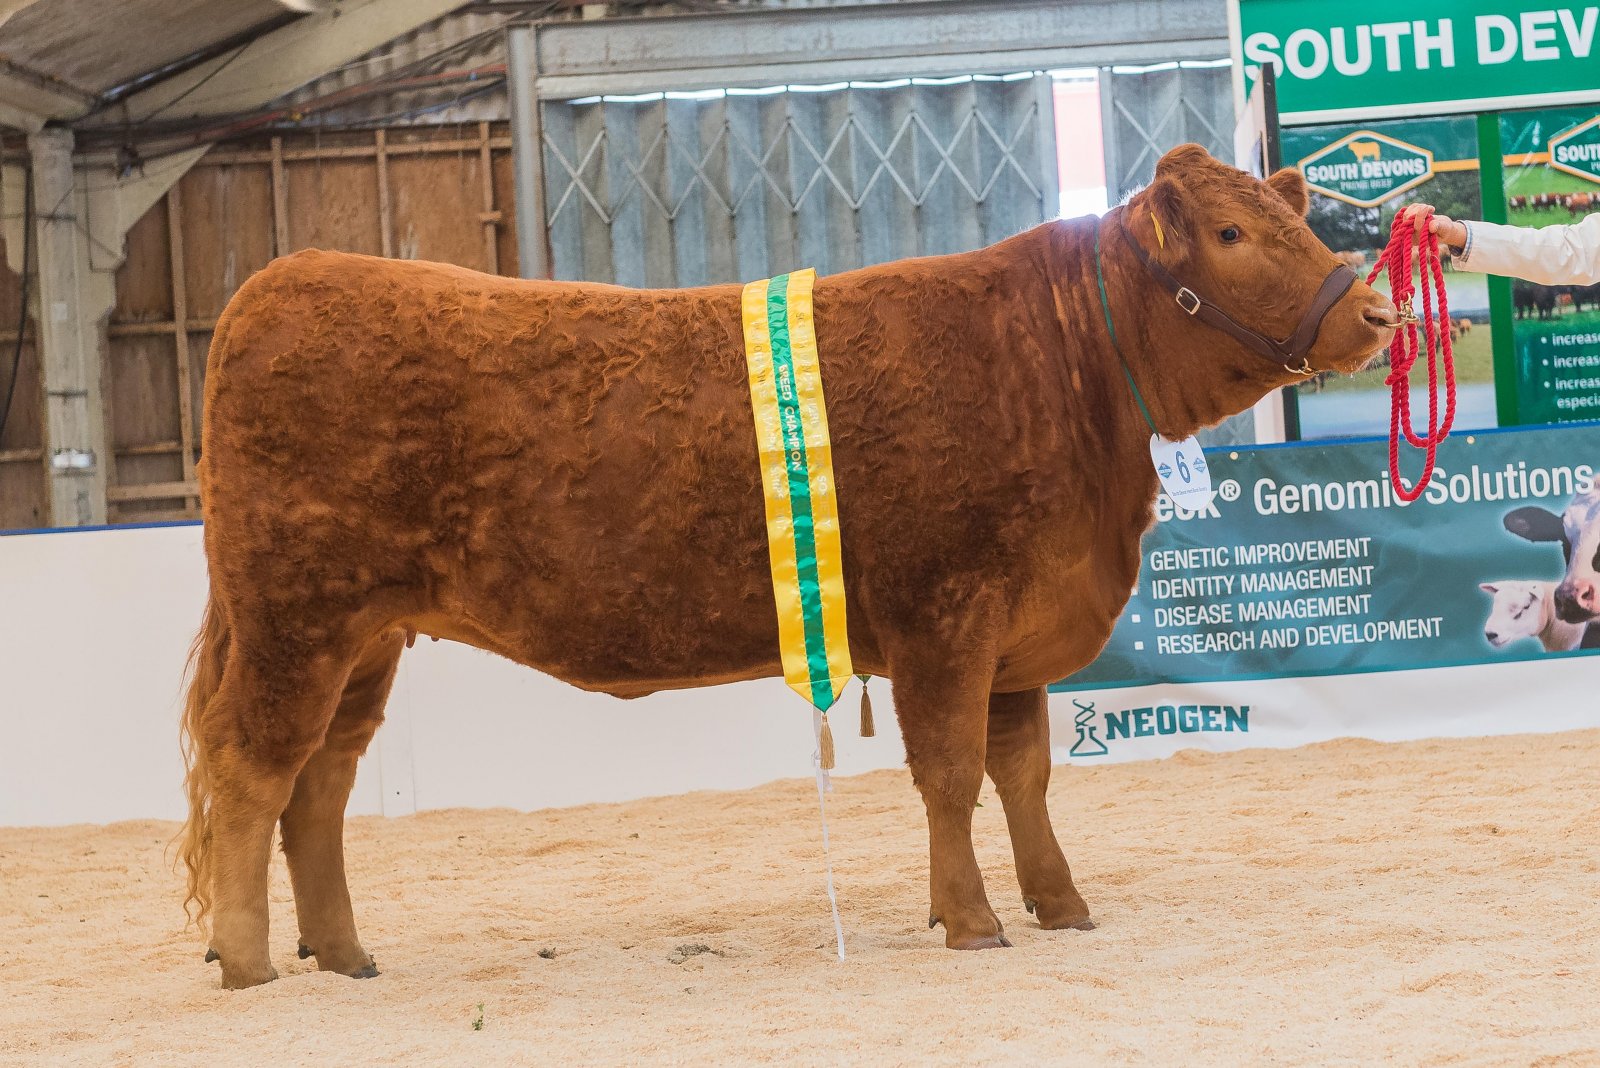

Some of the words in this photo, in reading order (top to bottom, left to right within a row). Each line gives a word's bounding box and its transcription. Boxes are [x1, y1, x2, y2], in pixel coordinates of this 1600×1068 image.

[1243, 18, 1456, 81] SOUTH
[1476, 7, 1600, 65] DEV
[1306, 163, 1358, 183] SOUTH
[1361, 157, 1426, 179] DEVONS
[1553, 355, 1600, 369] increas
[778, 364, 793, 401] BREED
[783, 405, 803, 472] CHAMPION
[1175, 450, 1191, 484] 6
[1424, 460, 1594, 502] Solutions
[1149, 545, 1230, 572] GENETIC
[1233, 537, 1372, 567] IMPROVEMENT
[1151, 573, 1236, 600] IDENTITY
[1239, 565, 1374, 595] MANAGEMENT
[1154, 602, 1234, 628] DISEASE
[1237, 594, 1372, 623] MANAGEMENT
[1156, 626, 1256, 655] RESEARCH
[1258, 625, 1300, 649] AND
[1304, 617, 1443, 647] DEVELOPMENT
[1104, 705, 1250, 740] NEOGEN
